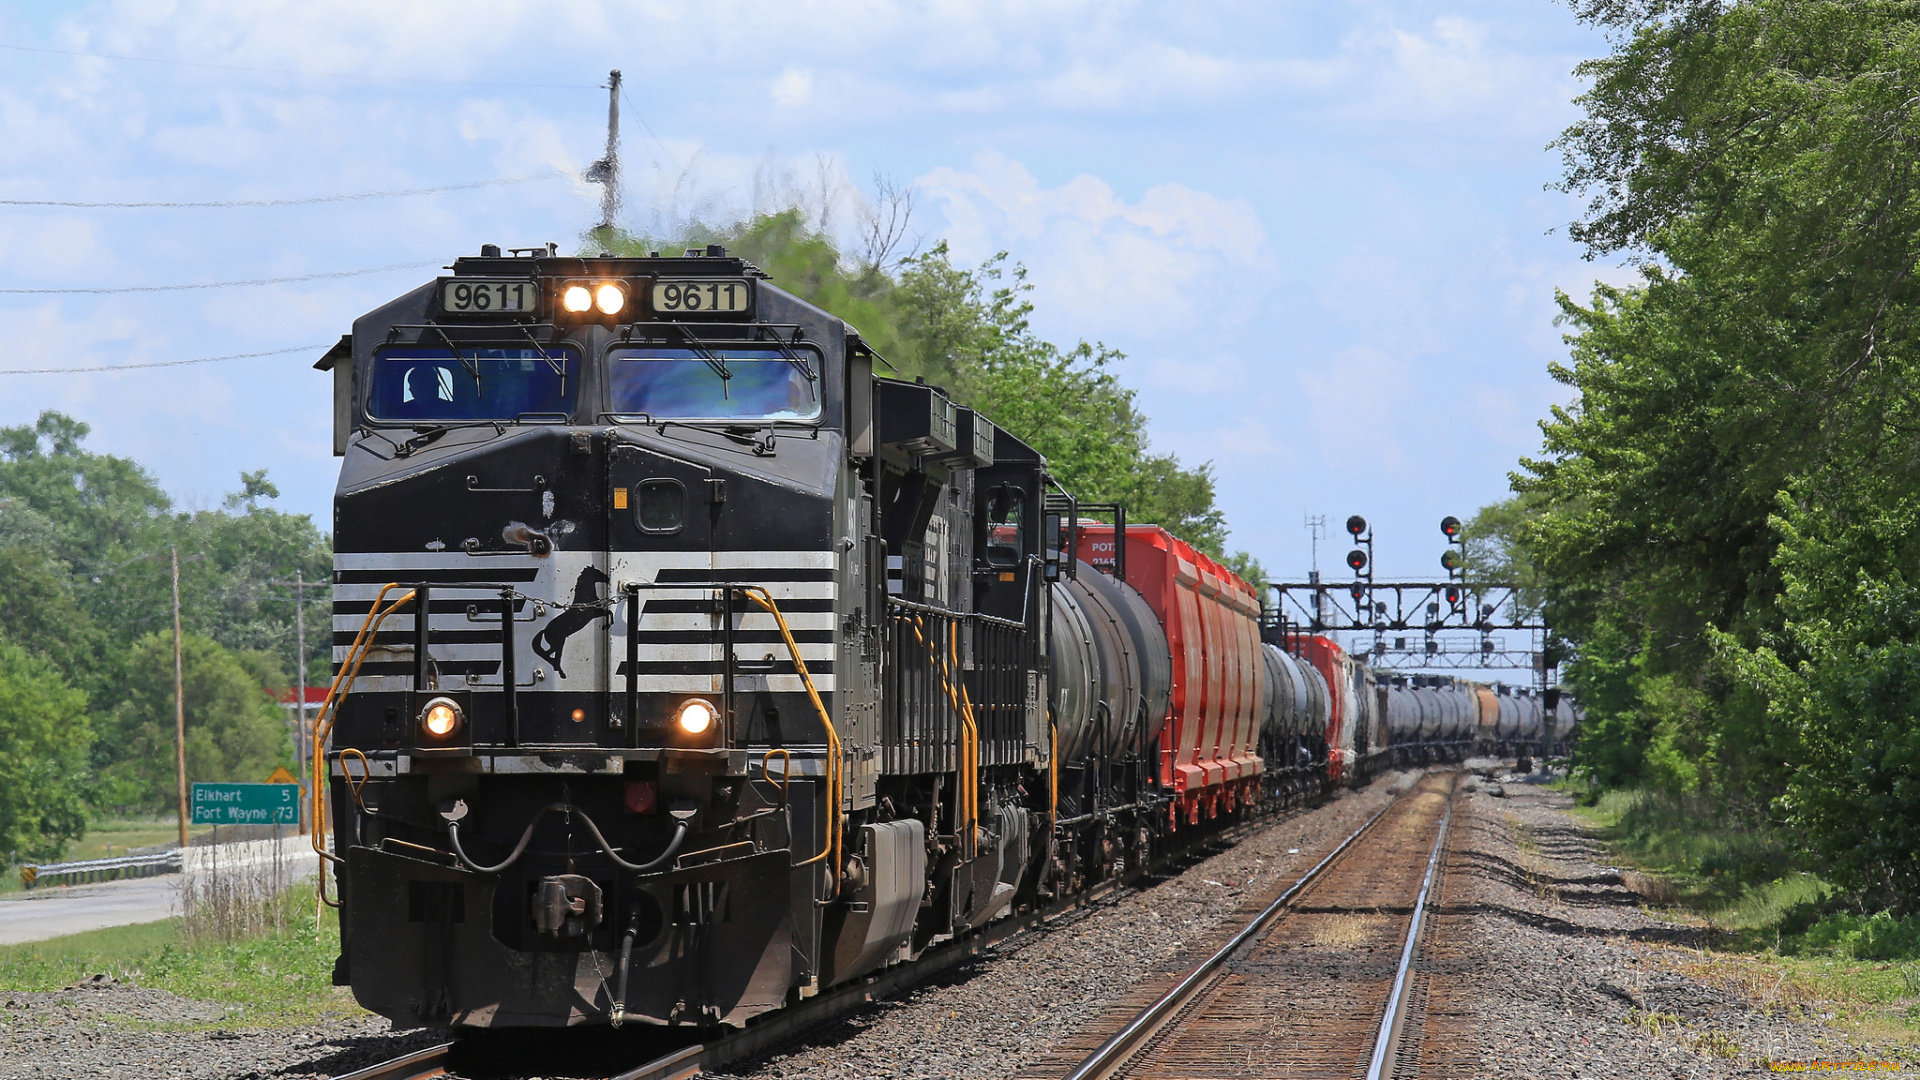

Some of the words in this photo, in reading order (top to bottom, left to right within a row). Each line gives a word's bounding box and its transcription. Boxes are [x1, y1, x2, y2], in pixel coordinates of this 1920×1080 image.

[454, 284, 525, 311] 9611
[663, 284, 736, 311] 9611
[1092, 543, 1116, 552] POT
[196, 789, 242, 802] Elkhart
[282, 789, 290, 802] 5
[196, 806, 221, 819] Fort
[228, 807, 267, 822] Wayne
[276, 806, 293, 819] 73
